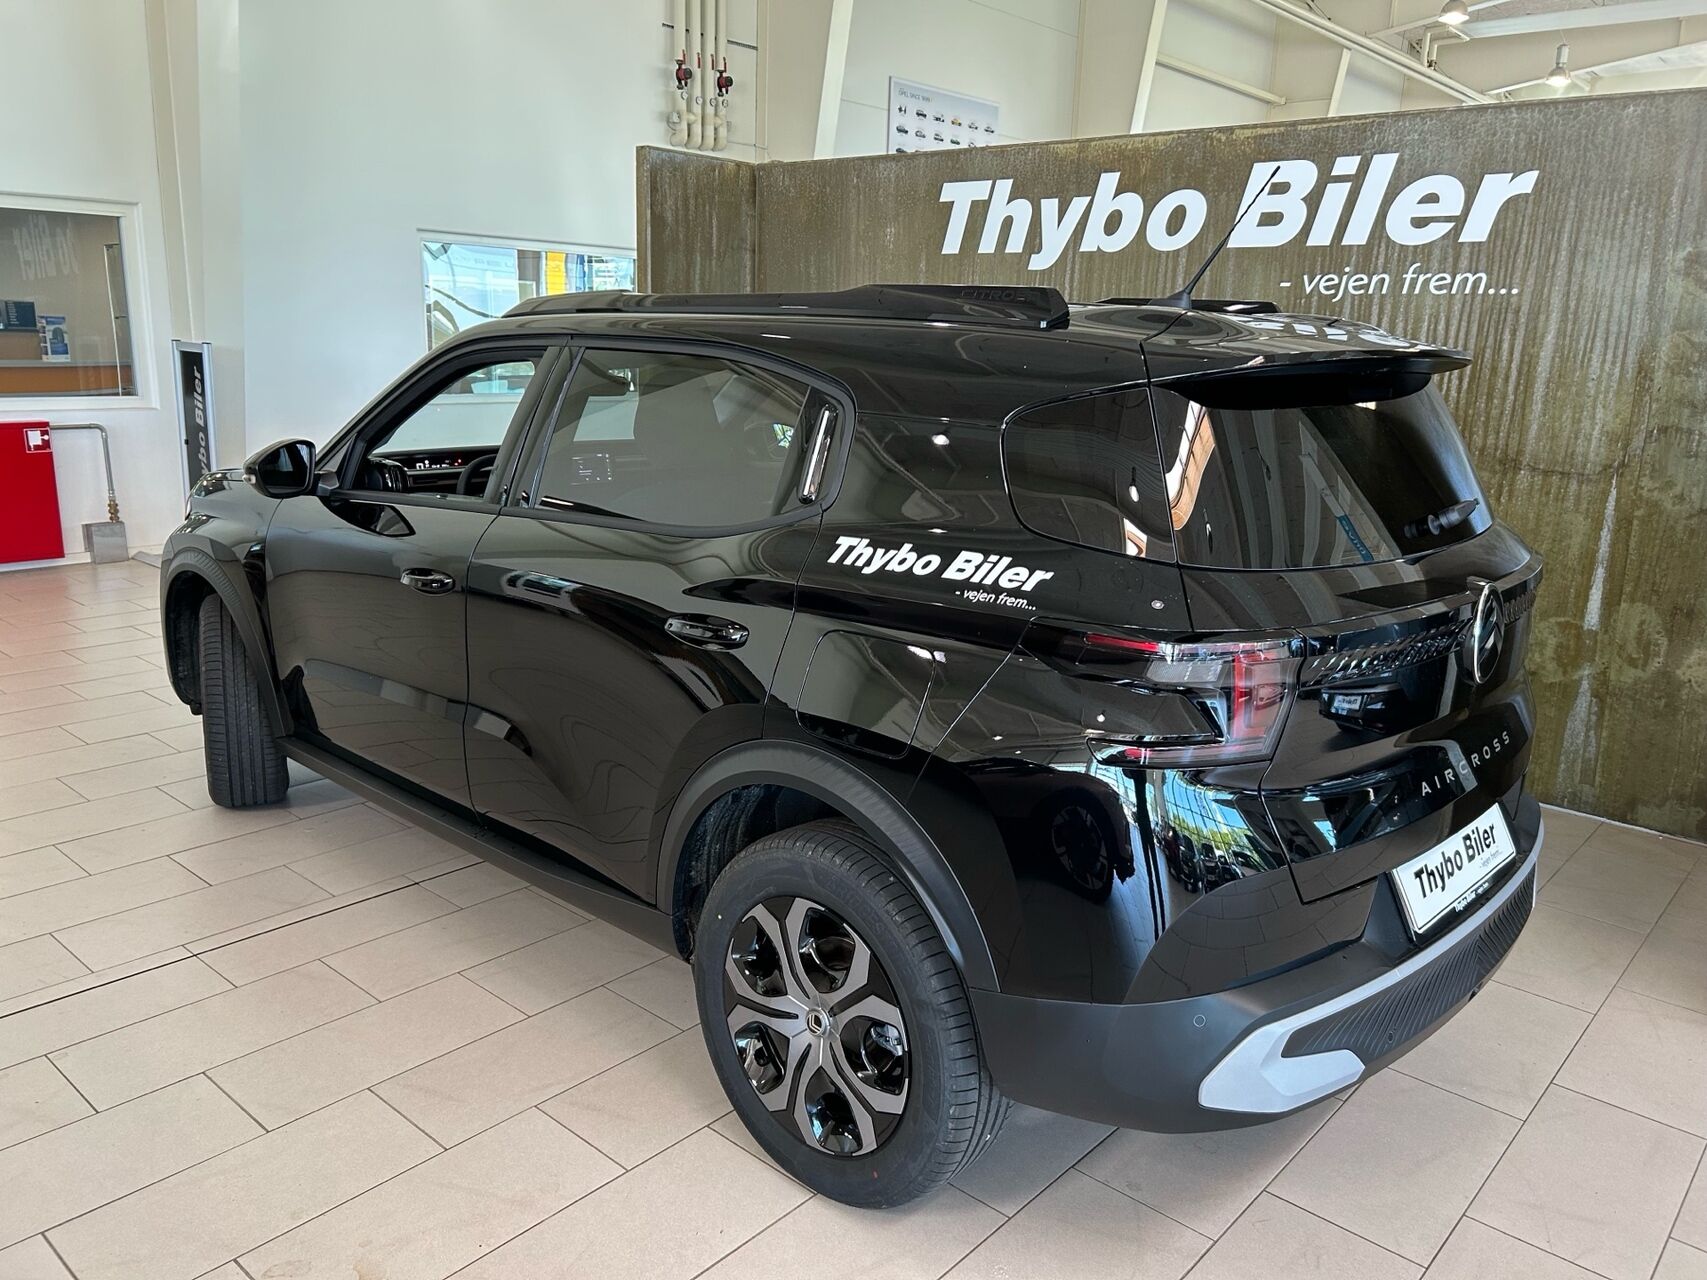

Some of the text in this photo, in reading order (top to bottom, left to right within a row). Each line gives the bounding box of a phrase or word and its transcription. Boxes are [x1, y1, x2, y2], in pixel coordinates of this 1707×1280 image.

[939, 153, 1538, 271] Thybo Biler
[961, 288, 1028, 301] CITRO
[1303, 267, 1389, 301] vejen
[1401, 262, 1520, 295] frem...
[193, 366, 205, 428] Biler
[827, 536, 1054, 592] Thybo Biler
[963, 589, 995, 604] vejen
[997, 593, 1037, 610] frem...
[1421, 731, 1510, 797] AIRCROSS
[1413, 823, 1496, 899] Thybo Biler
